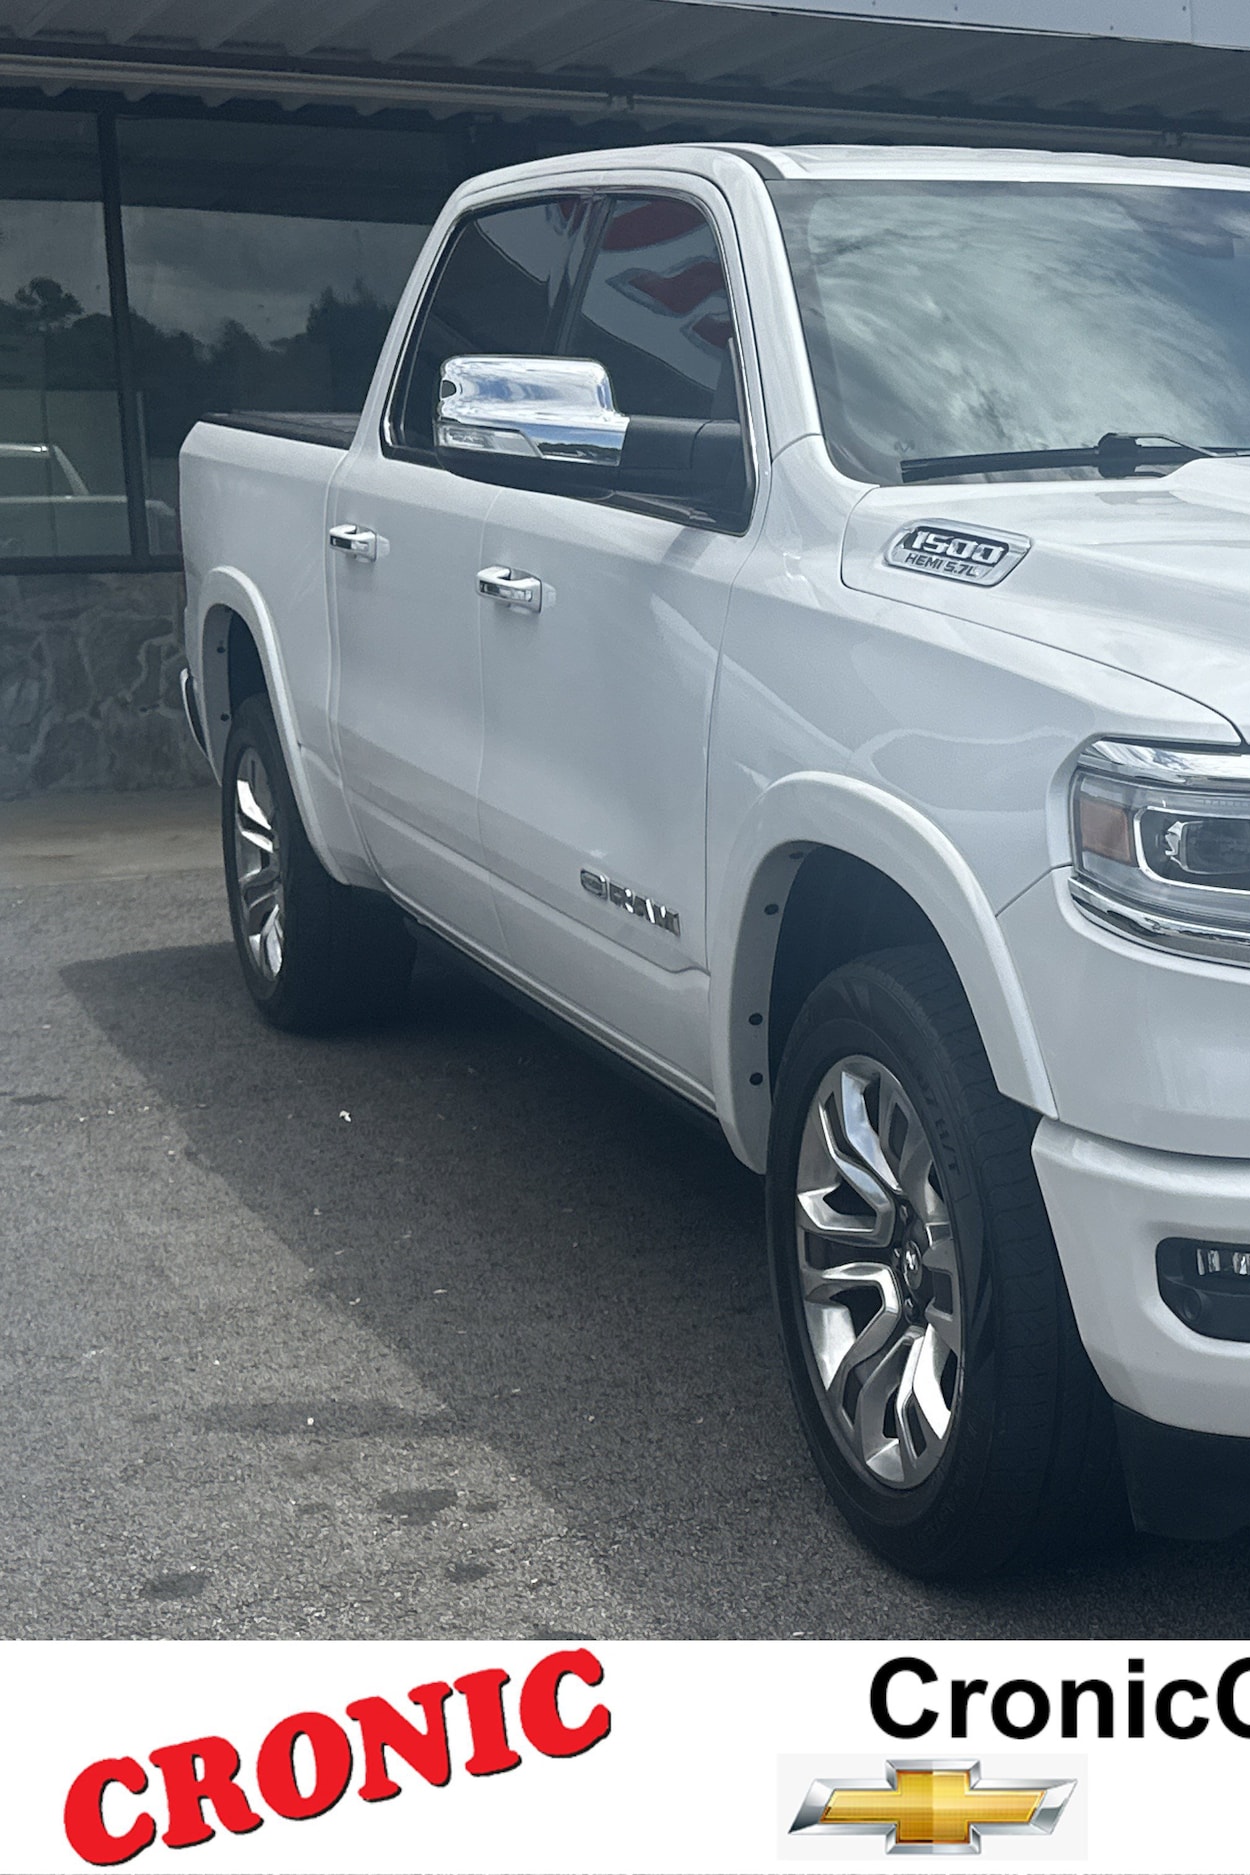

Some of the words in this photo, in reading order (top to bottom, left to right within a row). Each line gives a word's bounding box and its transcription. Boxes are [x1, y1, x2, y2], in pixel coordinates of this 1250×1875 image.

[911, 530, 1005, 564] 1500
[904, 552, 943, 570] HEMI
[943, 562, 978, 578] 5.7L
